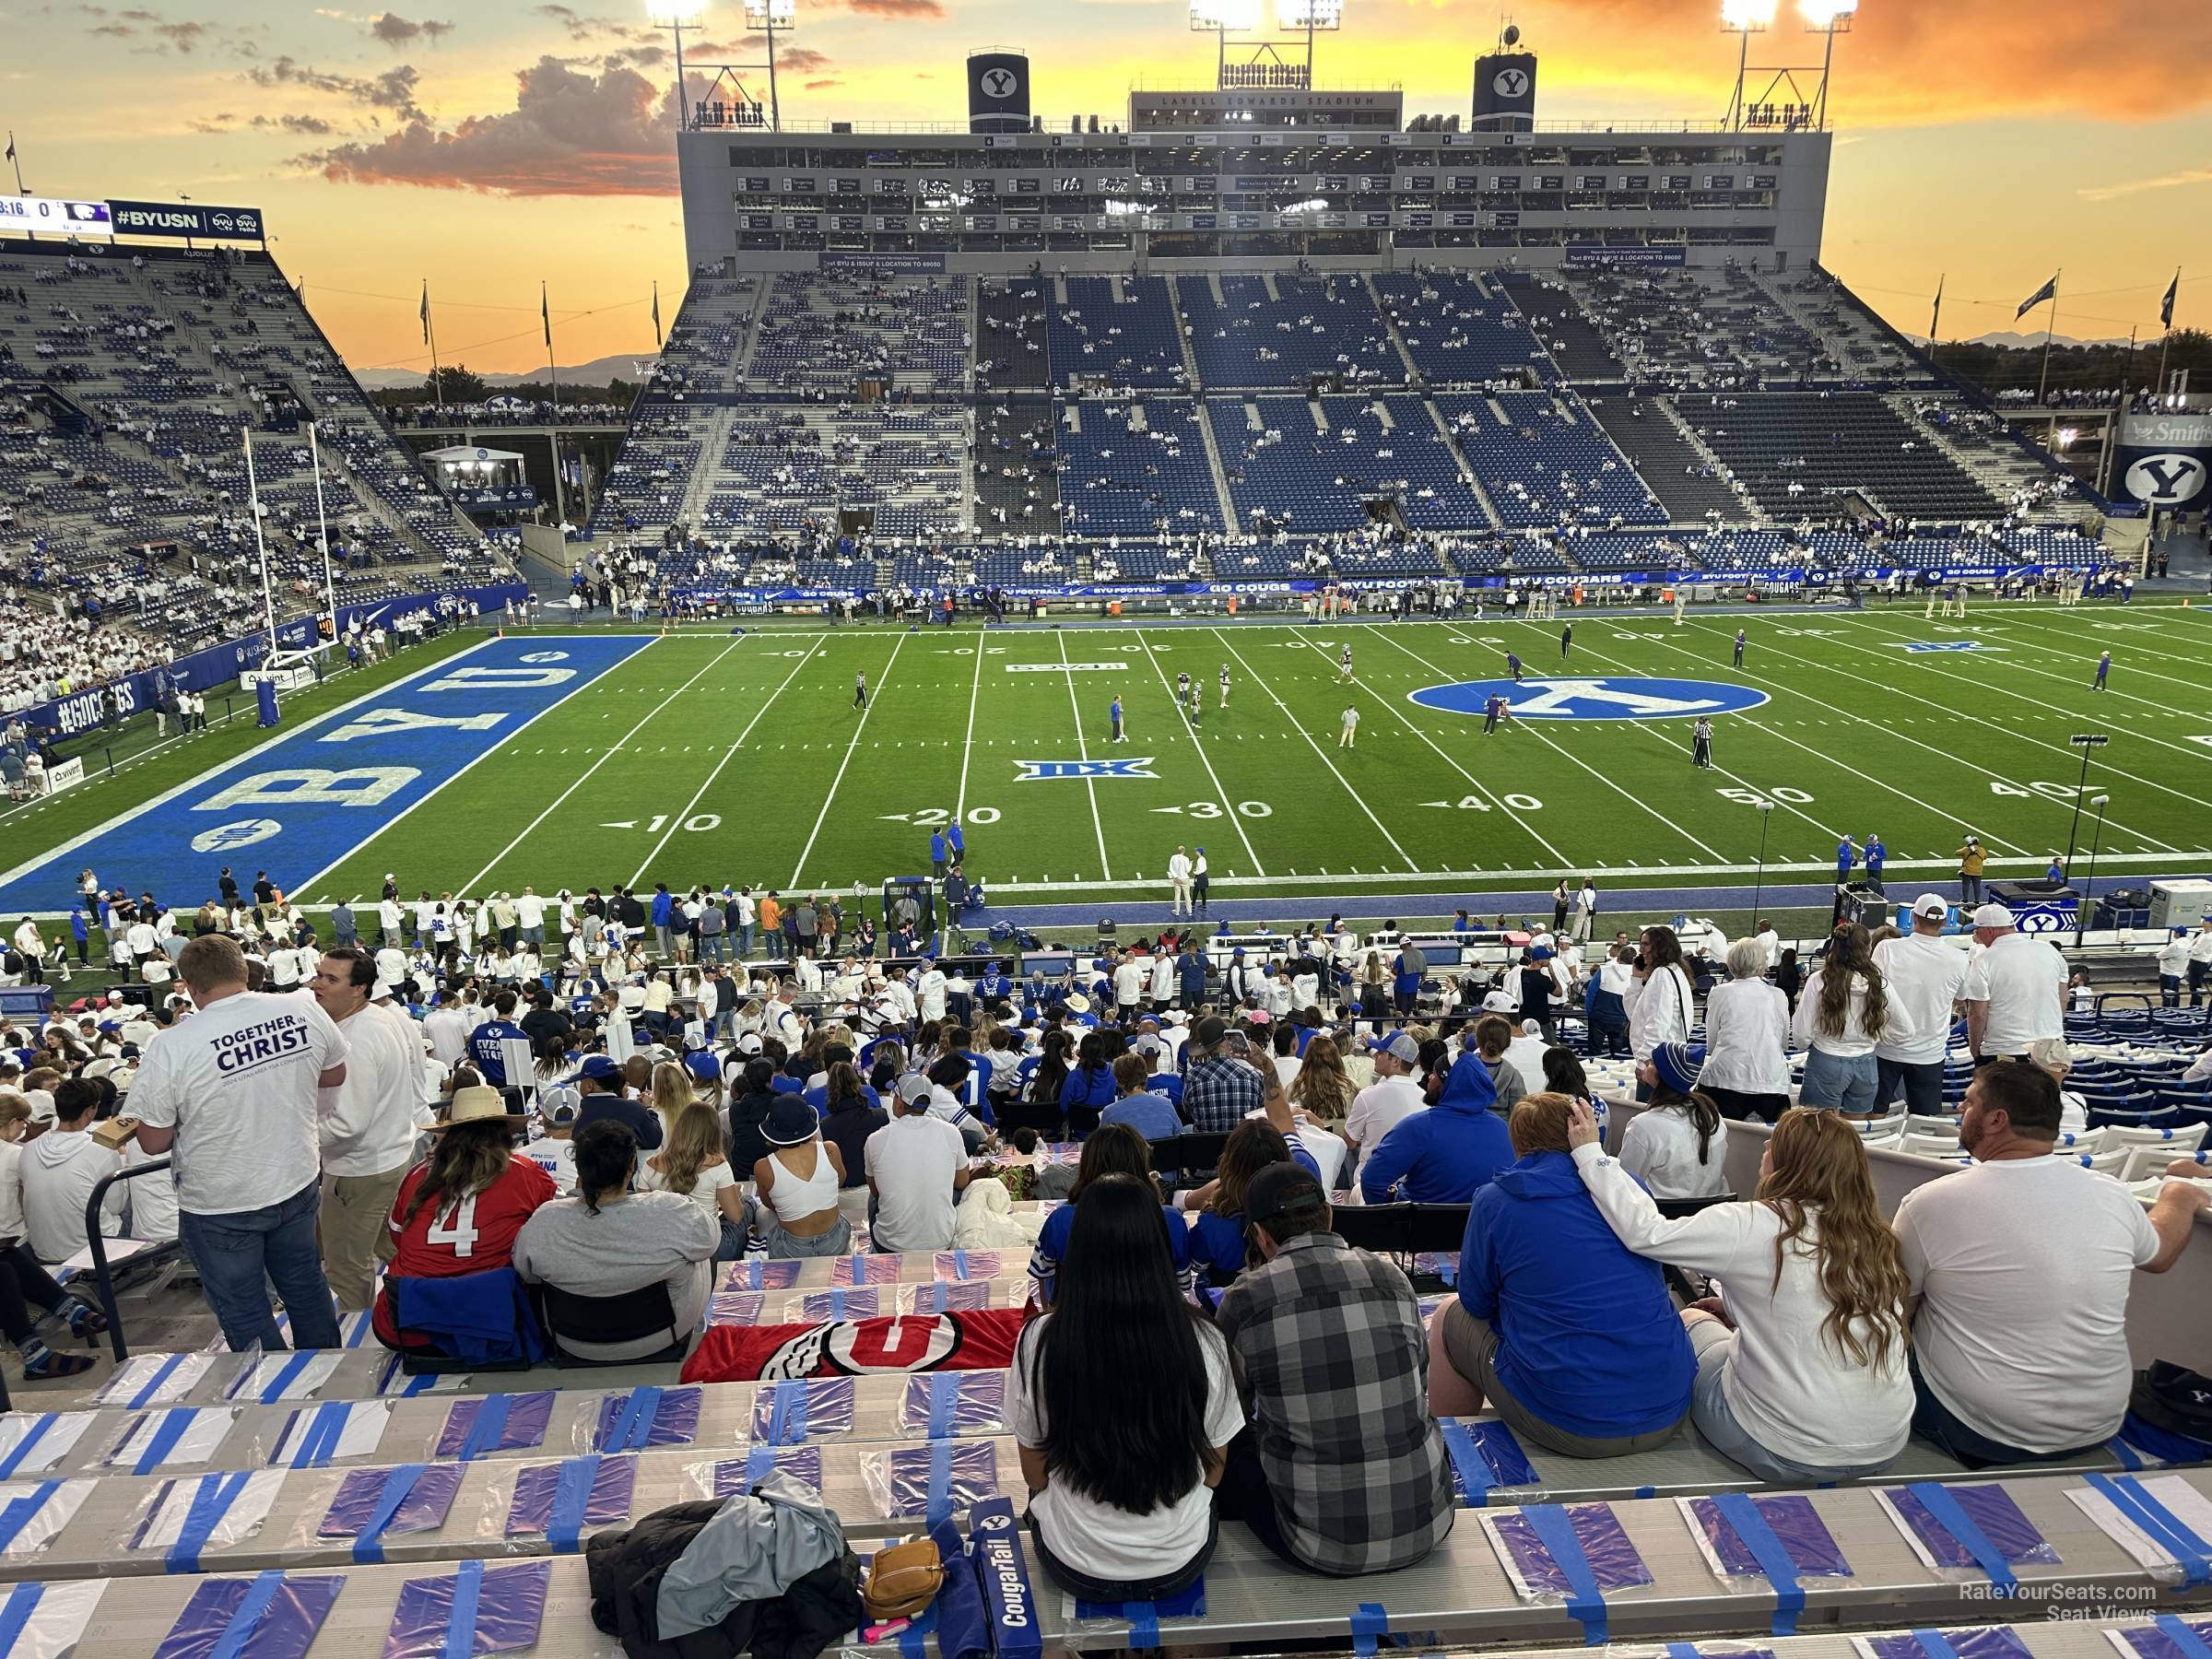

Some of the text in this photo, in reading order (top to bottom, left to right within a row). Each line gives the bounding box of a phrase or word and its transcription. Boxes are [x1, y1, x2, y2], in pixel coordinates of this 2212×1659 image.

[39, 203, 49, 217] 0
[117, 210, 198, 229] #BYUSN
[212, 217, 233, 228] byu
[236, 217, 257, 228] byu
[1209, 582, 1290, 593] GO COUGS
[1510, 574, 1622, 586] BYU COUGARS
[955, 647, 1007, 656] 20
[1285, 641, 1335, 649] 40
[782, 650, 829, 658] 10
[189, 666, 578, 812] BYU
[61, 765, 81, 779] vivint
[1714, 786, 1815, 806] 50
[1989, 781, 2078, 798] 40
[1187, 801, 1274, 819] 30
[1456, 794, 1544, 812] 40
[646, 814, 722, 832] 10
[912, 807, 1002, 826] 20
[431, 919, 445, 932] 96
[483, 959, 489, 969] 1
[210, 1015, 296, 1051] TOGETHER
[217, 1025, 308, 1071] CHRIST
[477, 1040, 503, 1051] EVEN
[479, 1050, 504, 1061] STAF
[966, 1069, 980, 1106] 1
[428, 1191, 478, 1257] 4
[986, 1538, 1029, 1628] CougarTail
